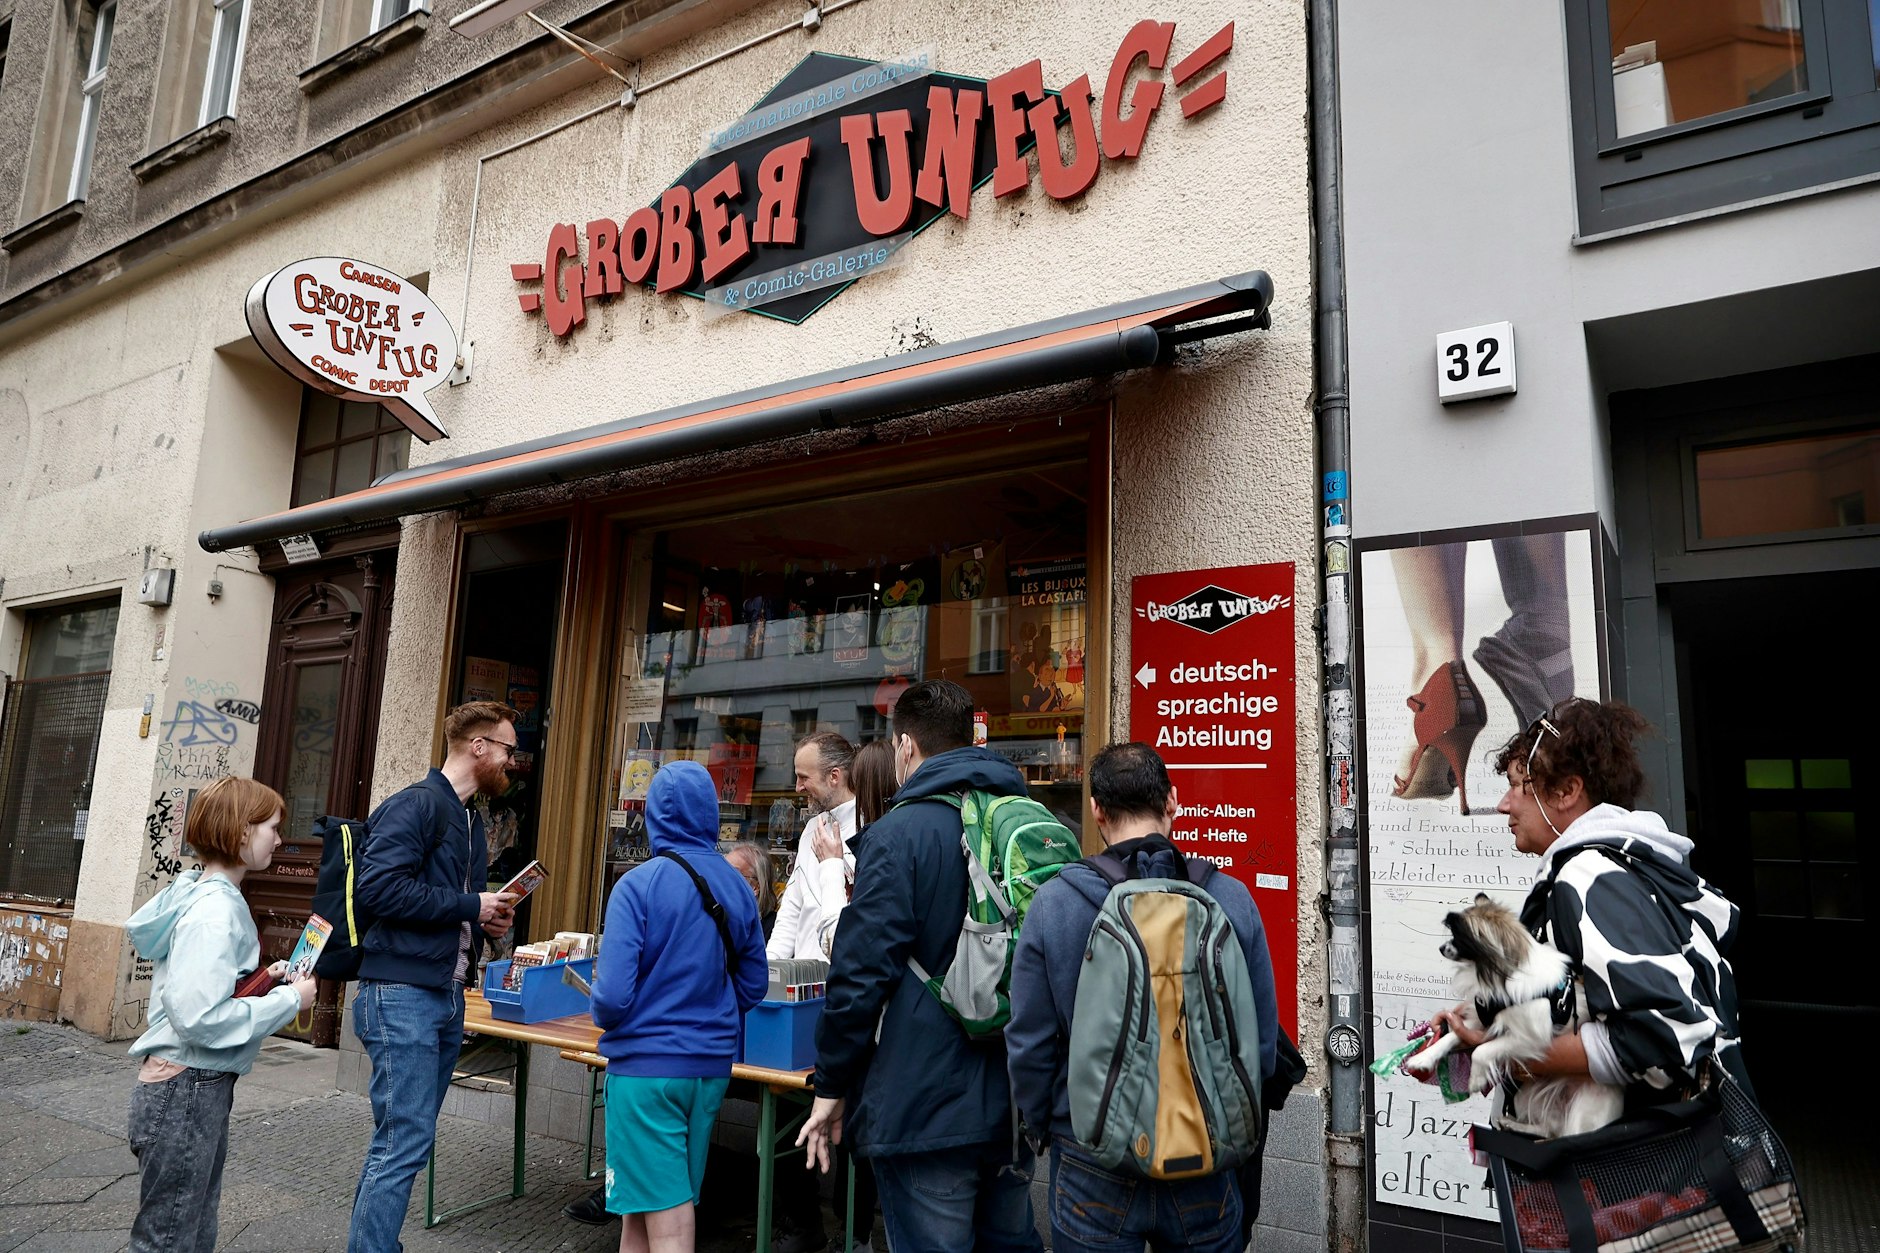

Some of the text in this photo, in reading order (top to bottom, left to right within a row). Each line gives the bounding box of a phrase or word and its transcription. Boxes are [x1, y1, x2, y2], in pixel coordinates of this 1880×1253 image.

[708, 50, 930, 149] Internationale Comics
[840, 19, 1176, 237] UNFUG
[340, 261, 402, 295] CARLSEN
[722, 244, 889, 306] & Comic-Galerie
[325, 319, 438, 378] UNFUG
[1446, 337, 1501, 382] 32
[310, 355, 409, 393] COMIC DEPOT
[1021, 581, 1039, 594] LES
[1021, 589, 1087, 607] LA CASTAFI
[1218, 594, 1282, 618] UNFUG
[835, 648, 866, 660] RYUK
[1169, 658, 1278, 684] deutsch-
[1157, 691, 1278, 719] sprachige
[1155, 724, 1273, 750] Abteilung
[1176, 804, 1256, 818] omic-Alben
[1172, 828, 1248, 843] und -Hefte
[1380, 818, 1412, 832] und
[615, 846, 652, 859] BLACKSAD
[1402, 839, 1469, 856] Schuhe
[1477, 840, 1504, 857] für
[1462, 865, 1509, 885] auch
[1377, 983, 1390, 992] Tel.
[1396, 972, 1403, 981] &
[1403, 973, 1426, 984] Spitze
[1427, 975, 1453, 984] GmbH
